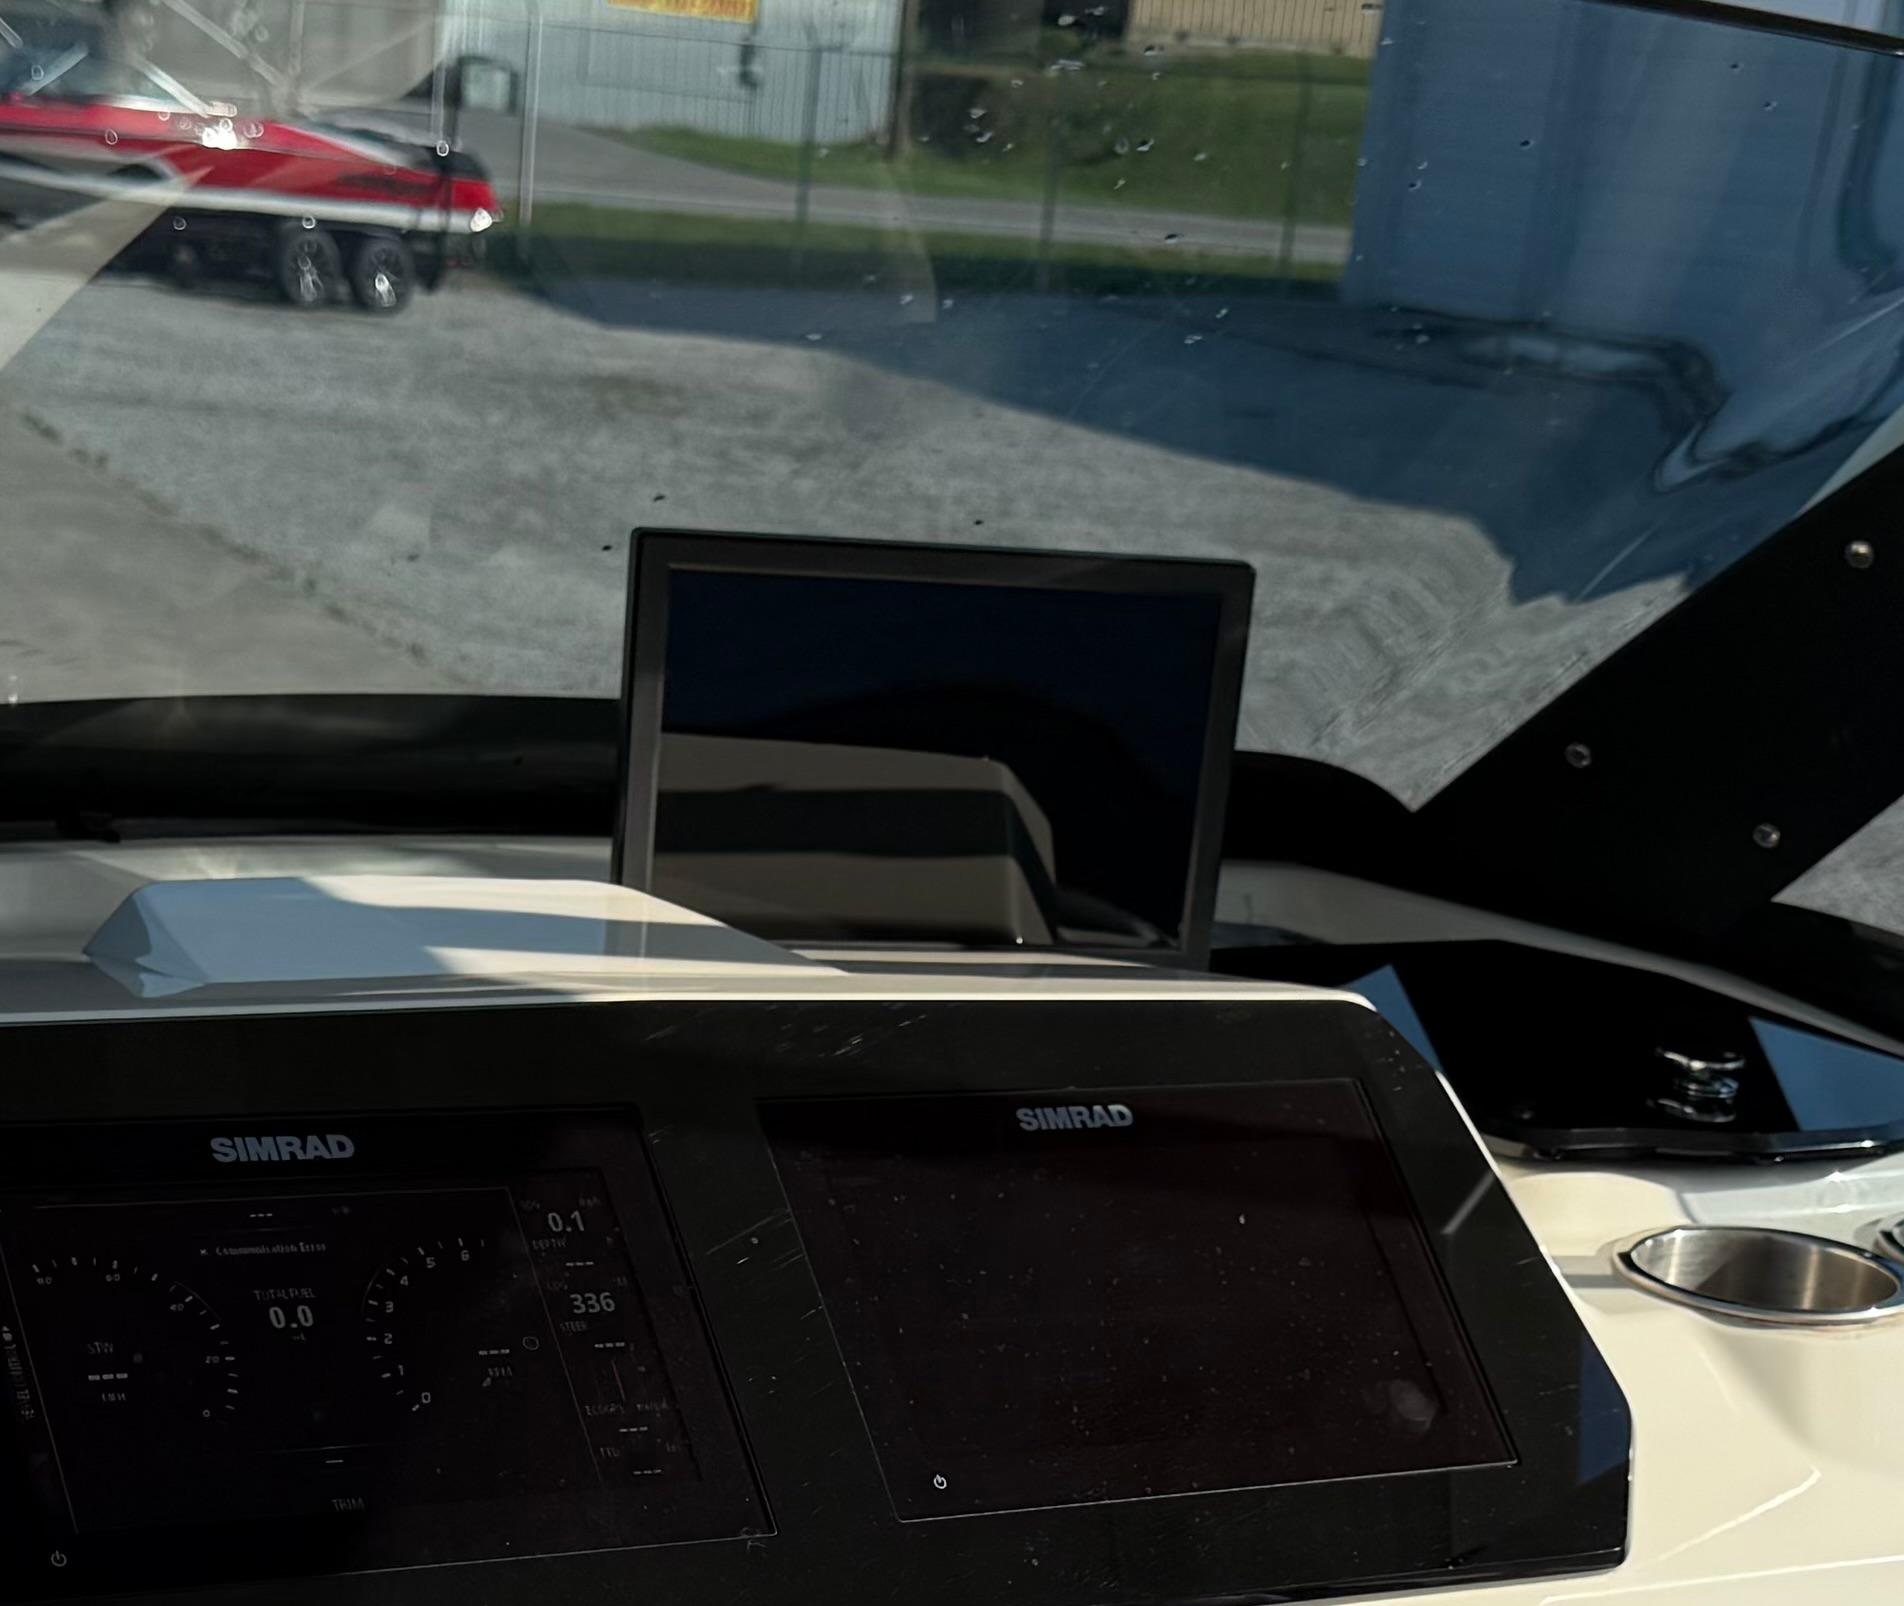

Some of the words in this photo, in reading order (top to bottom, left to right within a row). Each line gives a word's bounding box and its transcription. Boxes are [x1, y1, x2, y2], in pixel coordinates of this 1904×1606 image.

[1016, 1104, 1133, 1131] SIMRAD
[210, 1134, 355, 1163] SIMRAD
[547, 1209, 586, 1233] 0.1
[532, 1237, 567, 1251] DEPTH
[425, 1257, 437, 1268] 5
[460, 1250, 471, 1261] 6
[399, 1275, 410, 1286] 4
[253, 1288, 289, 1302] TOTAL
[288, 1287, 317, 1300] FUEL
[384, 1301, 395, 1313] 3
[569, 1292, 616, 1314] 336
[268, 1304, 315, 1330] 0.0
[383, 1333, 394, 1345] 2
[420, 1392, 432, 1404] 0
[202, 1408, 211, 1419] 0
[331, 1496, 366, 1513] TRIM
